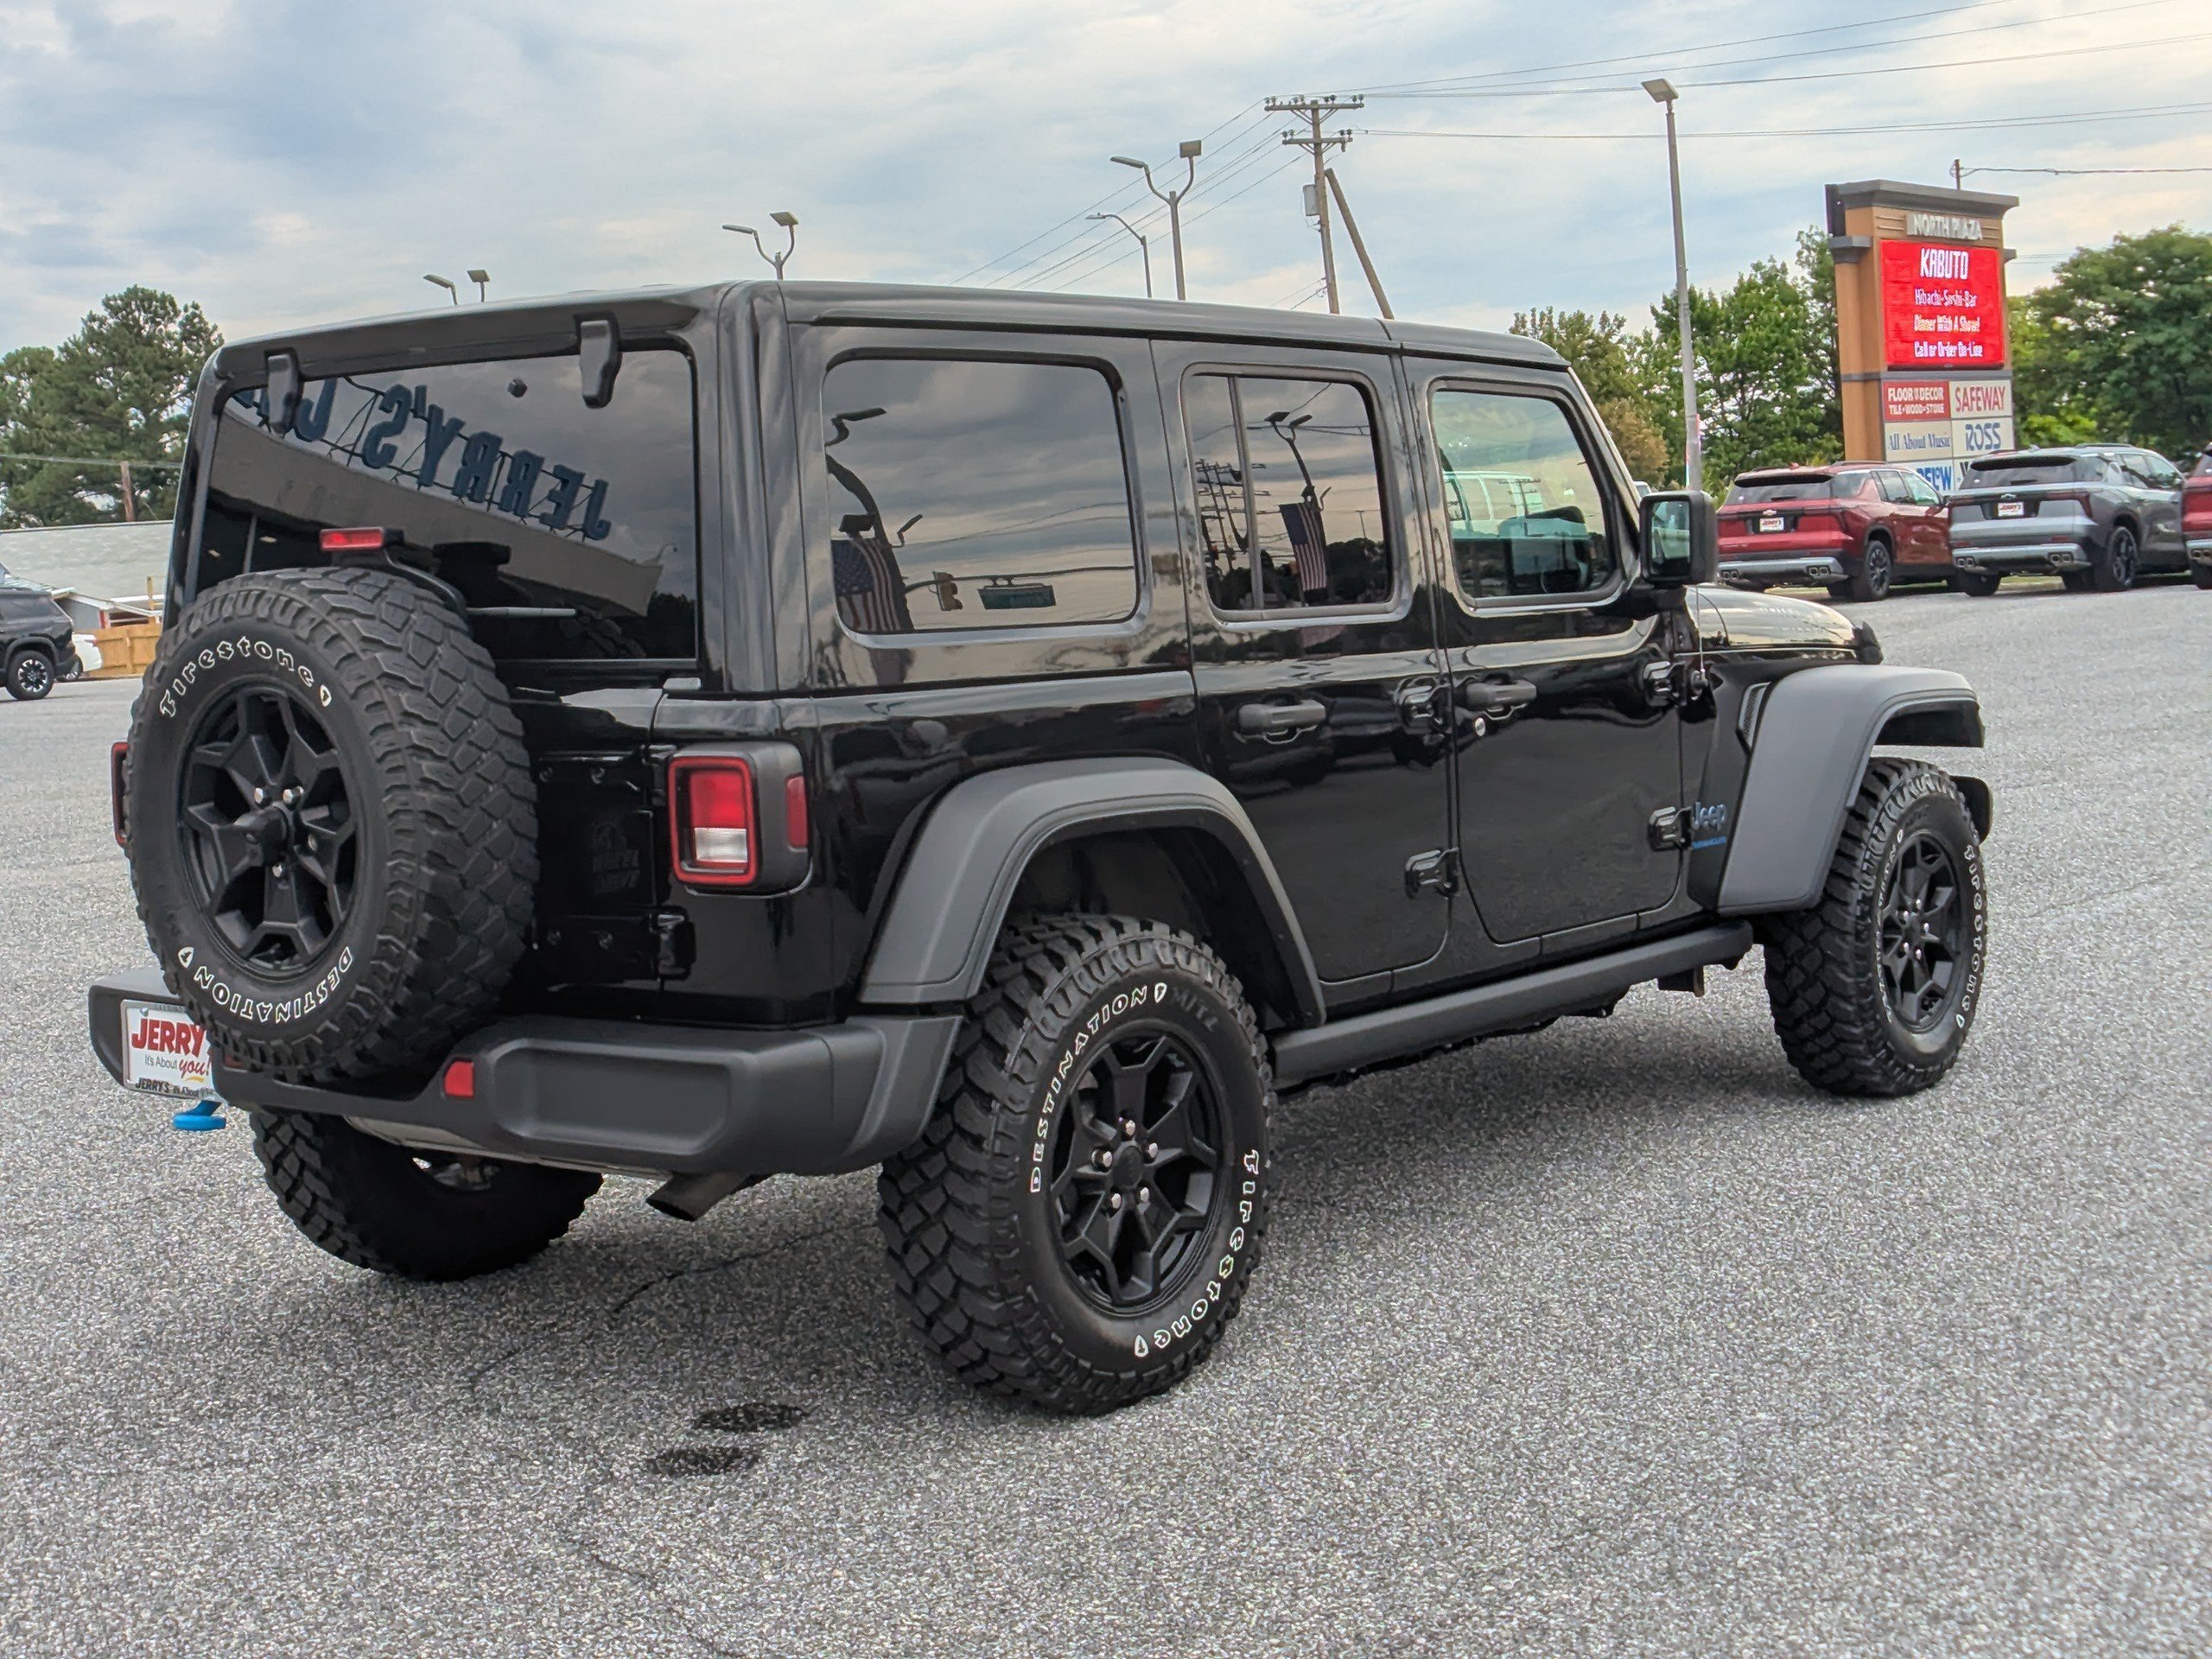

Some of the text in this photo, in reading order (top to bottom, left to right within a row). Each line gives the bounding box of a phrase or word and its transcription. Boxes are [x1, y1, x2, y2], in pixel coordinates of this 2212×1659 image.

[1912, 213, 1983, 240] NORTH PLAZA
[1920, 247, 1969, 280] KABUTO
[1887, 386, 1913, 402] FLOOR
[1919, 386, 1944, 401] DECOR
[1955, 386, 2005, 412] SAFEWAY
[1890, 432, 1951, 451] All About Music
[1965, 422, 2001, 452] ROSS
[1692, 801, 1727, 830] Jeep
[194, 946, 353, 1024] DESTINATION
[131, 1018, 208, 1058] JERRY
[144, 1053, 212, 1079] It's About you!
[1030, 985, 1147, 1192] DESTINATION
